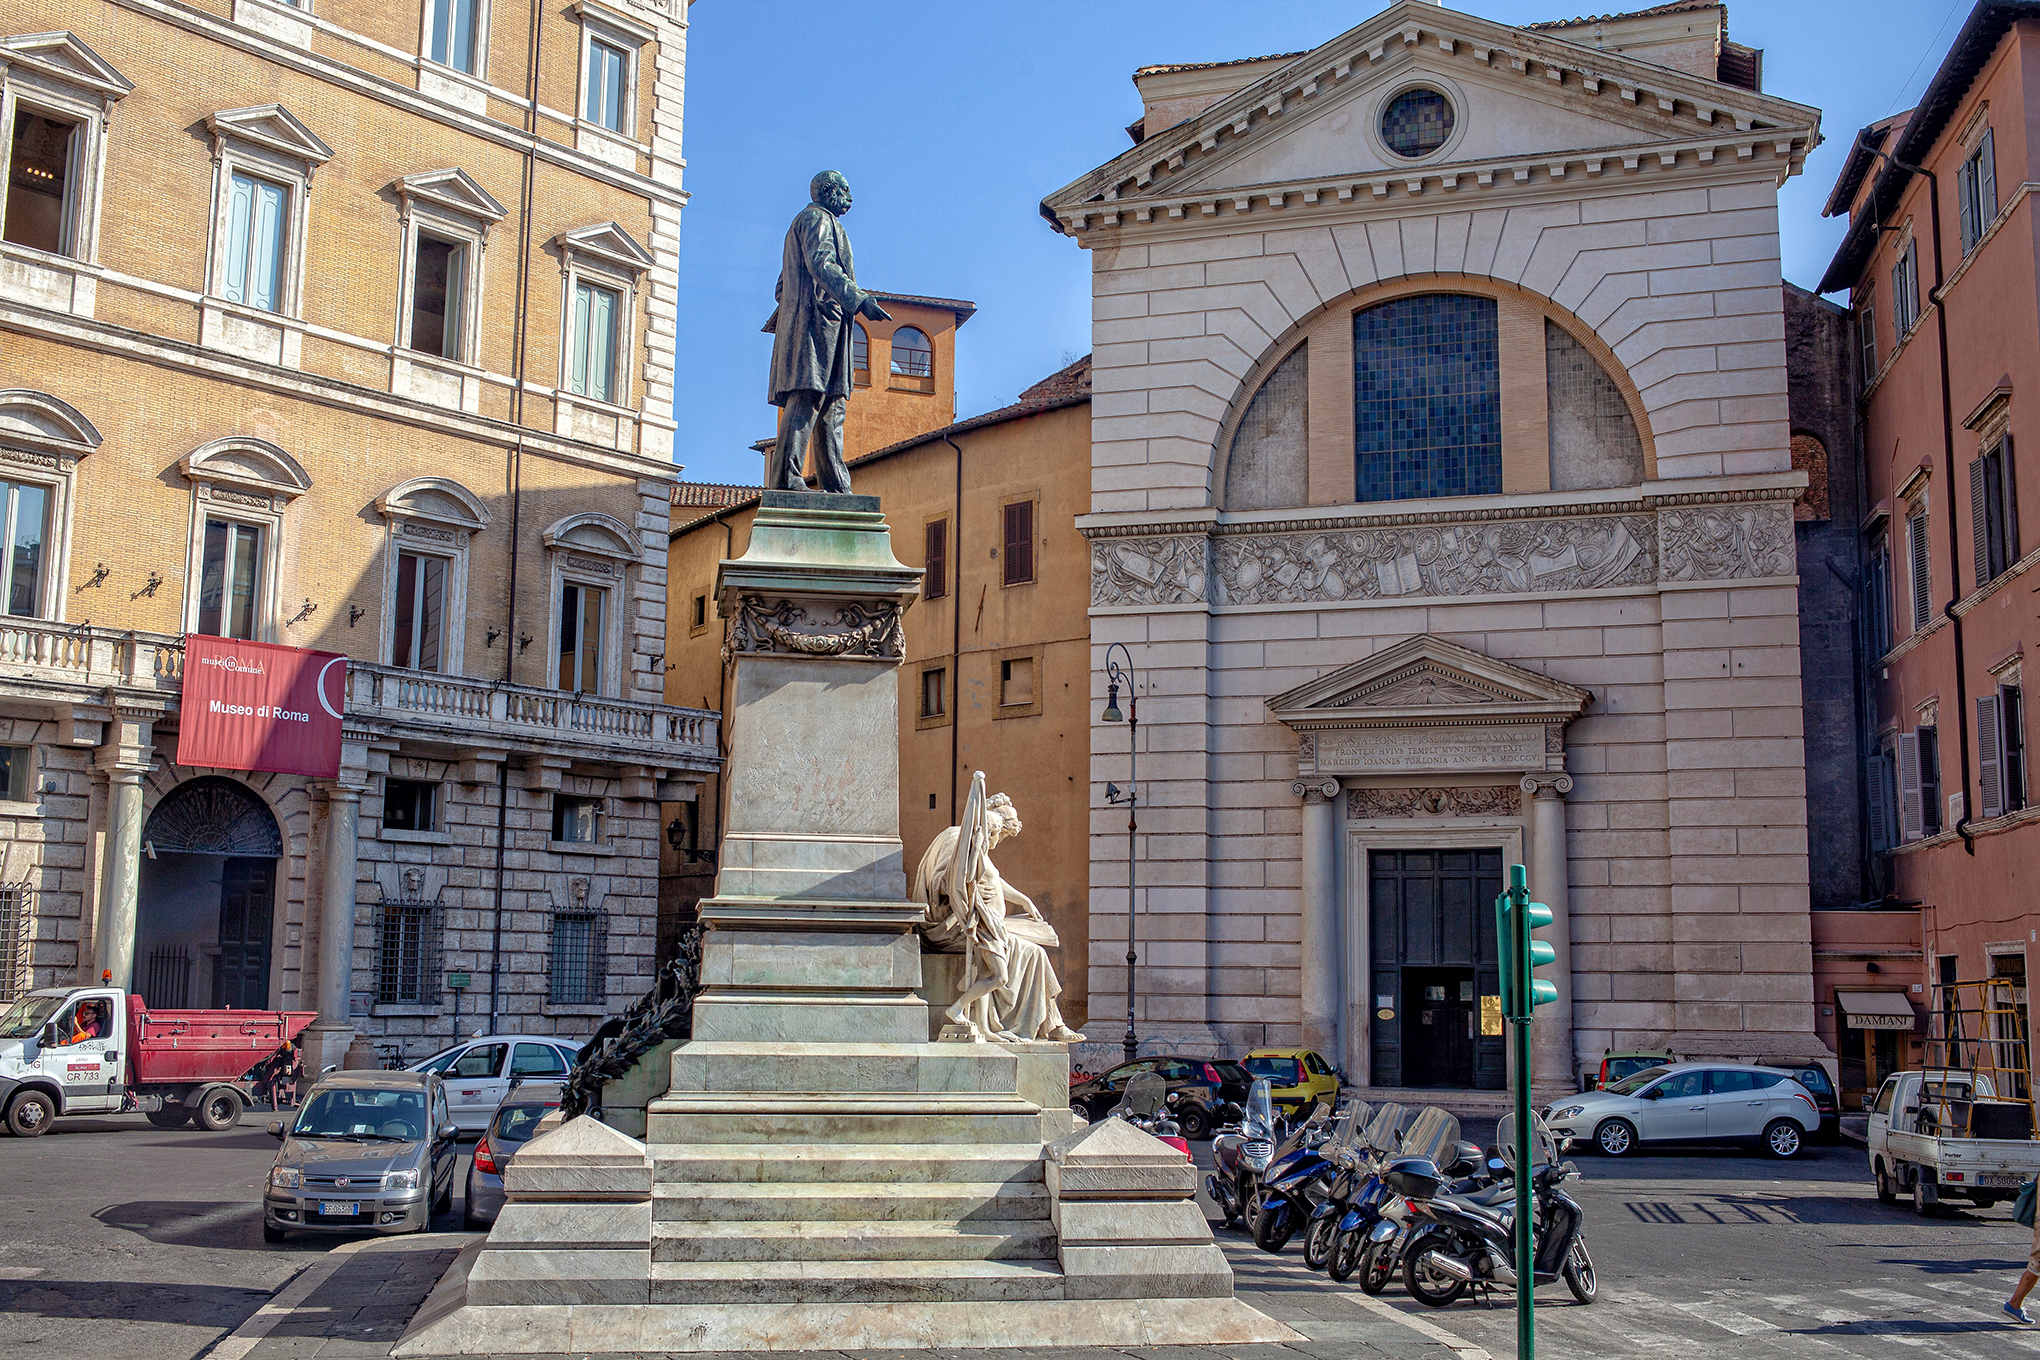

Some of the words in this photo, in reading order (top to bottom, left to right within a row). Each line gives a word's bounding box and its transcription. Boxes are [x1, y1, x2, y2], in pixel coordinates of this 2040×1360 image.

[210, 699, 253, 716] Museo
[257, 705, 269, 717] di
[272, 706, 309, 722] Roma
[1322, 737, 1333, 746] SS
[1337, 735, 1397, 746] PANTALEONI
[1402, 735, 1413, 745] ET
[1463, 732, 1537, 743] CALASANCTIO
[1334, 748, 1375, 756] FRONTEM
[1379, 747, 1404, 755] HVIVS
[1407, 746, 1438, 755] TEMPLI
[1441, 745, 1488, 755] MVNIFICVS
[1491, 744, 1523, 753] EREXIT
[1319, 758, 1360, 766] MARCHIO
[1364, 757, 1400, 766] IOANNES
[1404, 755, 1448, 765] TORLONIA
[1452, 756, 1478, 764] ANNO
[1499, 754, 1540, 763] MDCCCVI
[1855, 1015, 1908, 1026] DAMIANI
[67, 1072, 81, 1081] CR
[84, 1071, 100, 1081] 733
[1984, 1176, 1995, 1185] DX
